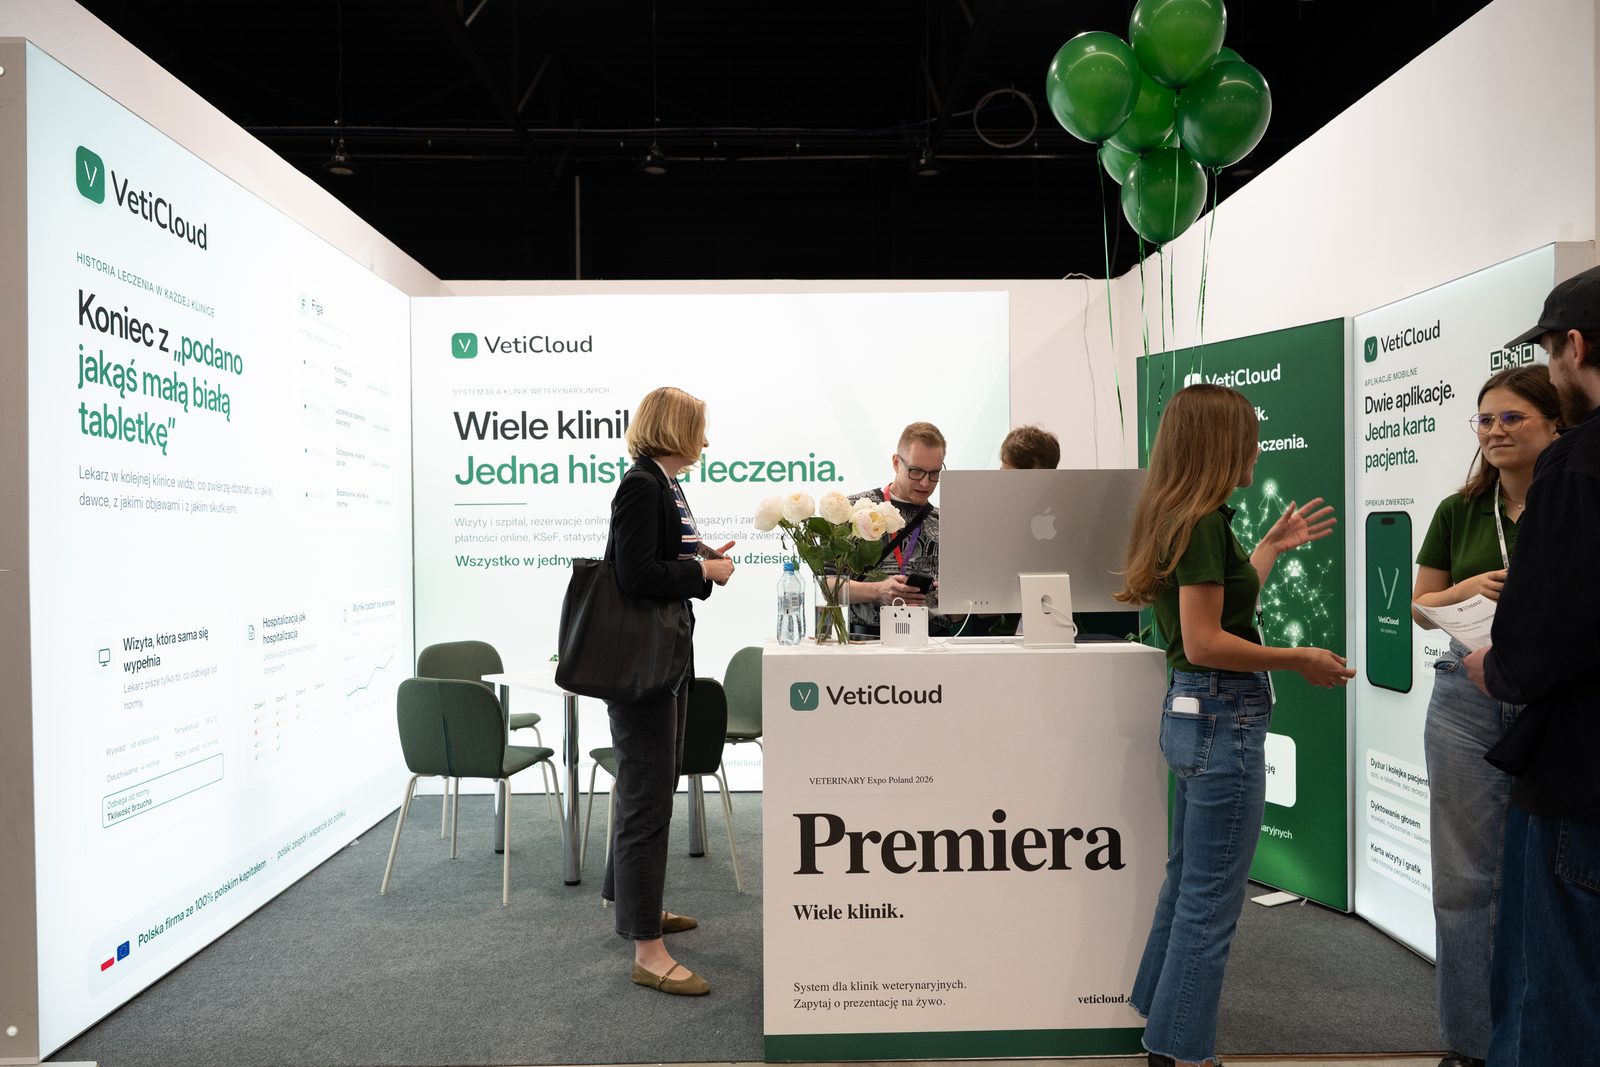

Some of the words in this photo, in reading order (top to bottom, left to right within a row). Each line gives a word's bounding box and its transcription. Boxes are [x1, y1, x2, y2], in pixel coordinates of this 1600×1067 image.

[111, 170, 208, 250] VetiCloud
[76, 252, 116, 278] HISTORIA
[118, 268, 154, 293] LECZENIA
[155, 284, 162, 296] W
[164, 286, 190, 309] KAŻDEJ
[191, 298, 215, 318] KLINICE
[78, 288, 154, 348] Koniec
[158, 329, 168, 353] z
[174, 334, 243, 376] „podano
[1381, 320, 1440, 353] VetiCloud
[484, 335, 592, 354] VetiCloud
[78, 344, 138, 399] jakąś
[142, 372, 188, 413] małą
[192, 377, 230, 422] białą
[1205, 363, 1281, 388] VetiCloud
[1364, 373, 1392, 387] APLIKACJE
[1393, 367, 1418, 381] MOBILNE
[530, 386, 610, 394] WETERYNARYJNYCH
[1365, 393, 1393, 414] Dwie
[1396, 380, 1455, 412] aplikacje.
[454, 410, 548, 440] Wiele
[1365, 420, 1400, 442] Jedna
[1403, 415, 1436, 436] karta
[455, 455, 558, 486] Jedna
[700, 452, 844, 483] leczenia.
[1366, 447, 1418, 473] pacjenta.
[79, 465, 108, 482] Lekarz
[112, 472, 118, 482] w
[120, 469, 150, 488] kolejnej
[152, 472, 176, 488] klinice
[197, 481, 206, 490] co
[80, 492, 111, 510] dawce,
[114, 498, 118, 508] z
[120, 496, 144, 510] jakimi
[146, 496, 180, 512] objawami
[186, 501, 190, 512] z
[190, 500, 208, 514] jakim
[1365, 498, 1384, 507] OPIEKUN
[1385, 497, 1414, 507] ZWIERZĘCIA
[454, 518, 487, 528] Wizyty
[496, 516, 528, 529] szpital,
[530, 517, 582, 529] rezerwacje
[454, 532, 498, 545] płatności
[500, 532, 530, 544] online,
[533, 532, 560, 543] KSeF,
[455, 554, 520, 570] Wszystko
[524, 556, 534, 566] w
[262, 614, 298, 628] Hospitalizacja
[1378, 616, 1400, 625] VetiCloud
[123, 636, 154, 652] Wizyta,
[156, 632, 176, 646] która
[178, 632, 198, 643] sama
[198, 626, 209, 642] się
[262, 628, 298, 645] hospitalizacja
[1424, 646, 1438, 657] Czat
[124, 654, 160, 675] wypełnia
[124, 683, 144, 694] Lekarz
[145, 678, 160, 690] pisze
[826, 684, 942, 705] VetiCloud
[1371, 758, 1385, 769] Dyżur
[1389, 764, 1406, 778] kolejka
[809, 776, 866, 785] VETERINARY
[867, 776, 886, 787] Expo
[888, 775, 913, 784] Poland
[915, 775, 934, 784] 2026
[107, 806, 131, 822] Tkliwość
[131, 798, 152, 812] brzucha
[1371, 800, 1400, 820] Dyktowanie
[1401, 814, 1421, 829] głosem
[793, 809, 1126, 874] Premiera
[1371, 842, 1384, 856] Karta
[1385, 851, 1402, 866] wizyty
[138, 922, 164, 947] Polska
[165, 912, 184, 931] firma
[186, 906, 194, 918] ze
[194, 893, 213, 912] 100%
[214, 876, 239, 902] polskim
[239, 859, 266, 887] kapitałem
[277, 842, 291, 861] polski
[793, 904, 842, 920] Wiele
[847, 903, 904, 920] klinik.
[794, 982, 830, 994] System
[832, 981, 848, 992] dla
[850, 980, 879, 992] klinik
[881, 979, 967, 994] weterynaryjnych.
[793, 998, 831, 1011] Zapytaj
[834, 1001, 840, 1009] o
[842, 998, 899, 1011] prezentację
[902, 999, 913, 1008] na
[916, 996, 946, 1010] żywo.
